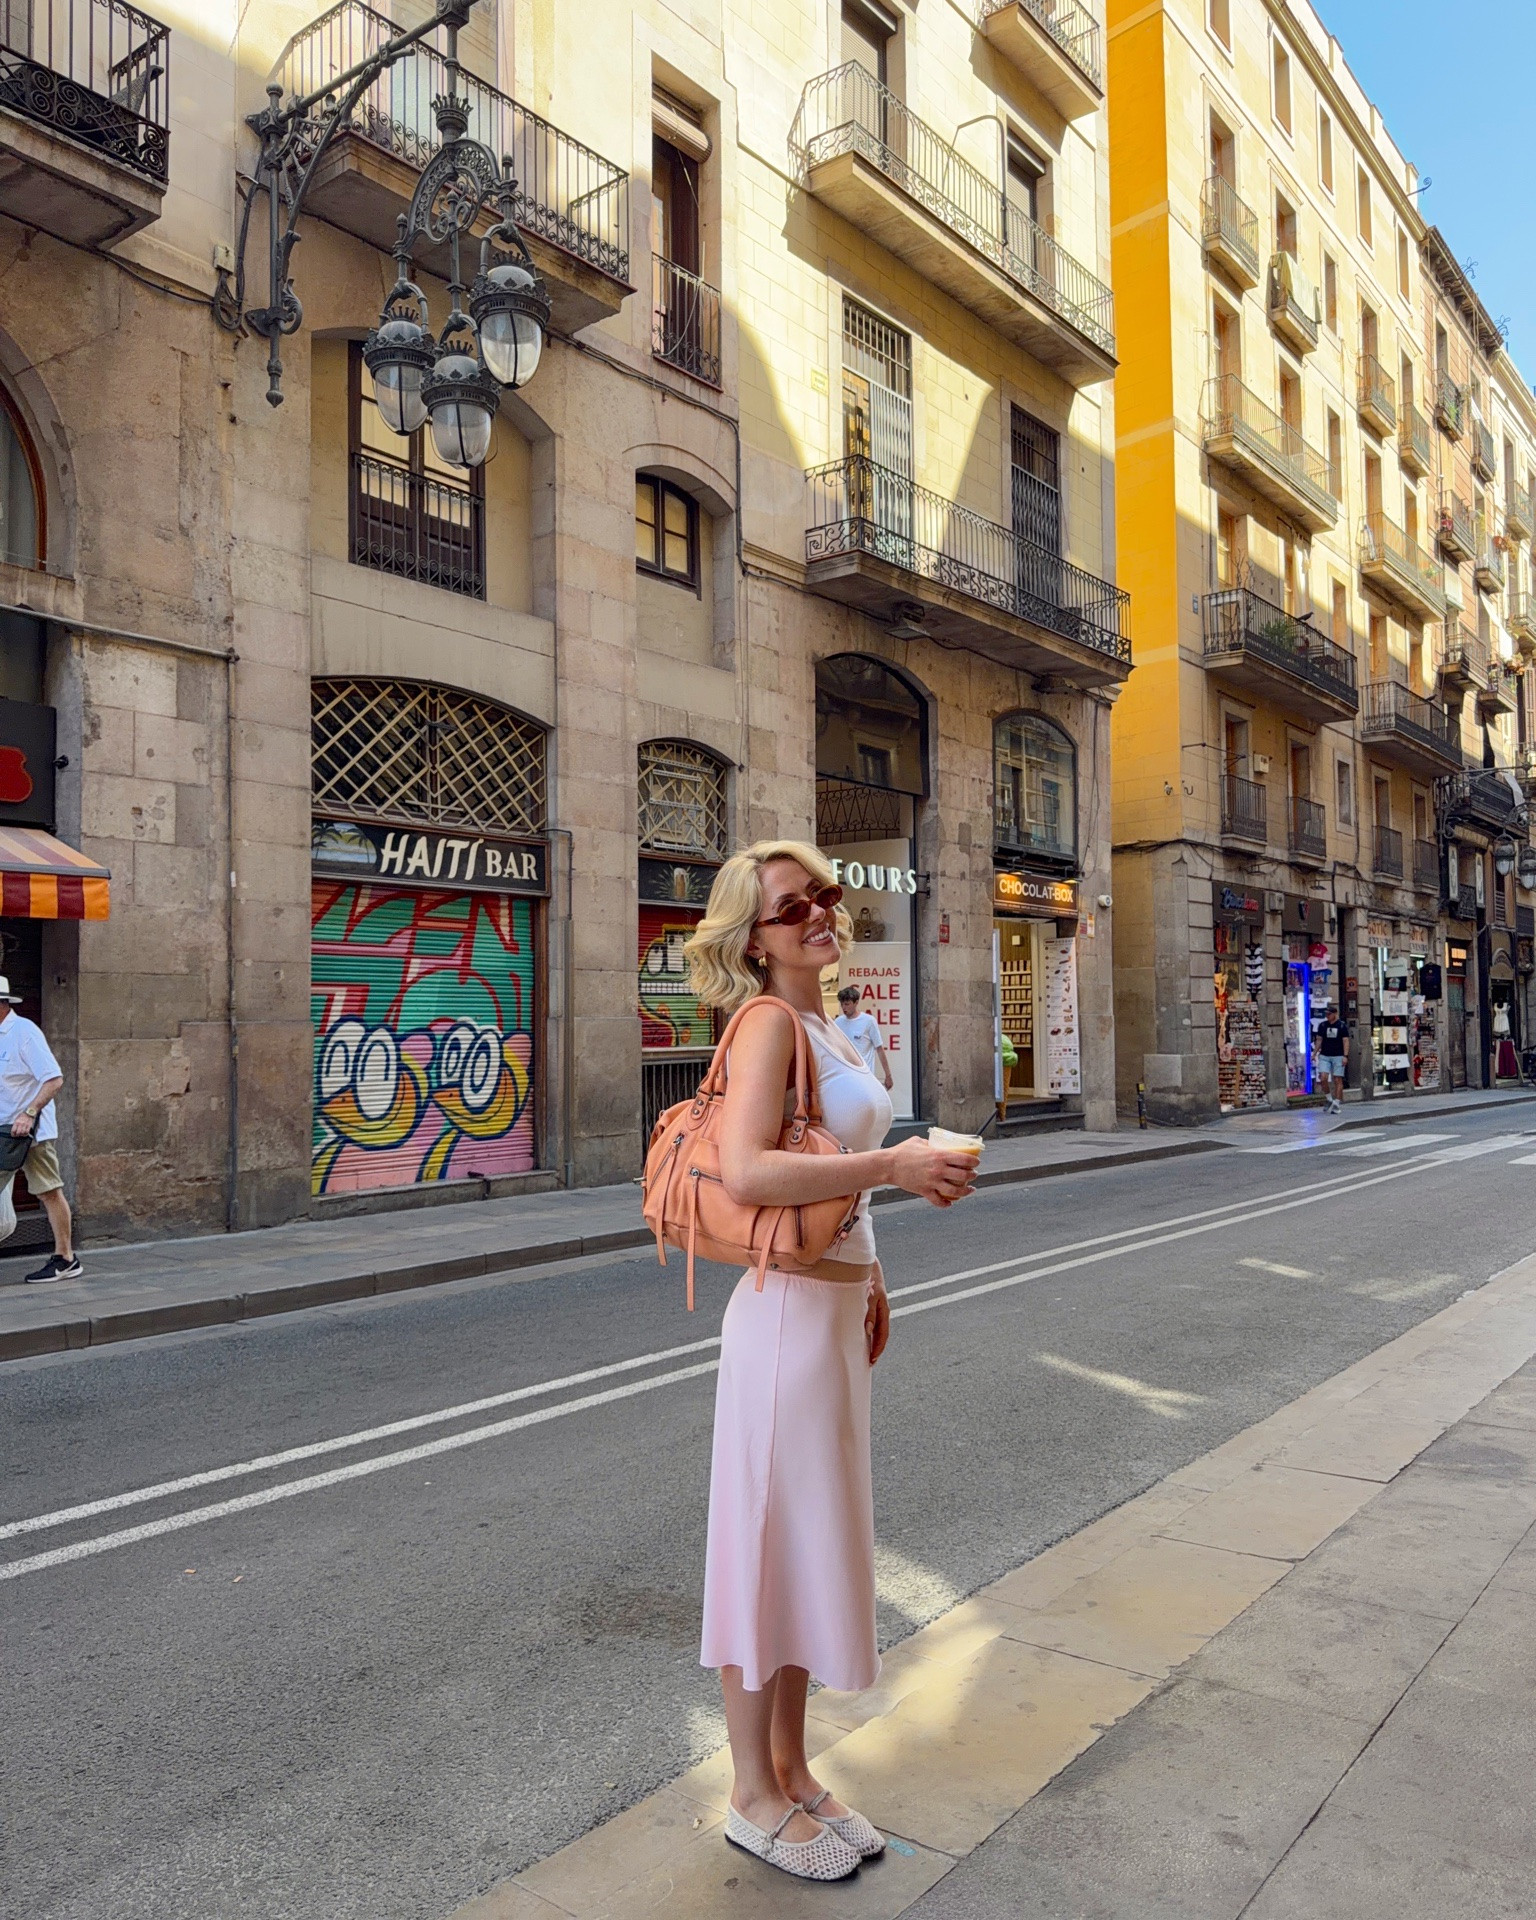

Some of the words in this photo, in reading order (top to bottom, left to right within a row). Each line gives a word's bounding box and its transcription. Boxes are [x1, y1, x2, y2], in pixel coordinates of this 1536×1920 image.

[485, 848, 538, 881] BAR
[999, 878, 1074, 903] CHOCOLAT-BOX
[848, 967, 900, 977] REBAJAS
[851, 984, 900, 1000] ALE
